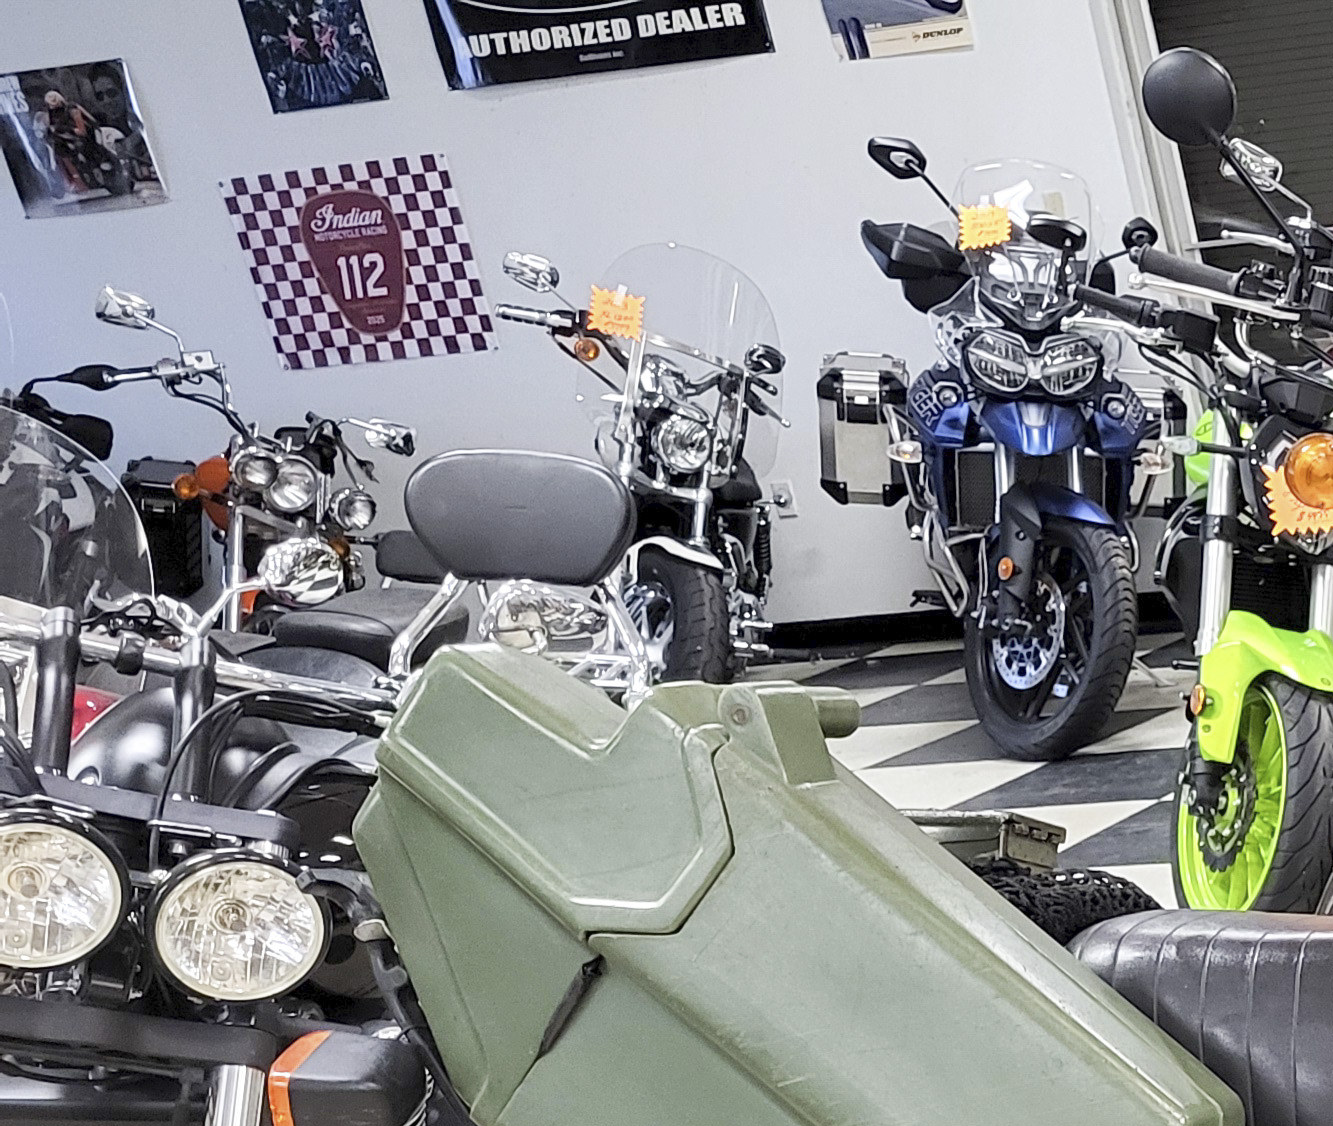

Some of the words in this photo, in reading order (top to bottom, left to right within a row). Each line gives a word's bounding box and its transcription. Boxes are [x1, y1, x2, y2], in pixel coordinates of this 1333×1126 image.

[460, 18, 632, 59] AUTHORIZED
[636, 2, 746, 39] DEALER
[922, 27, 963, 39] DUNLOP
[310, 203, 382, 232] Indian
[336, 251, 388, 300] 112
